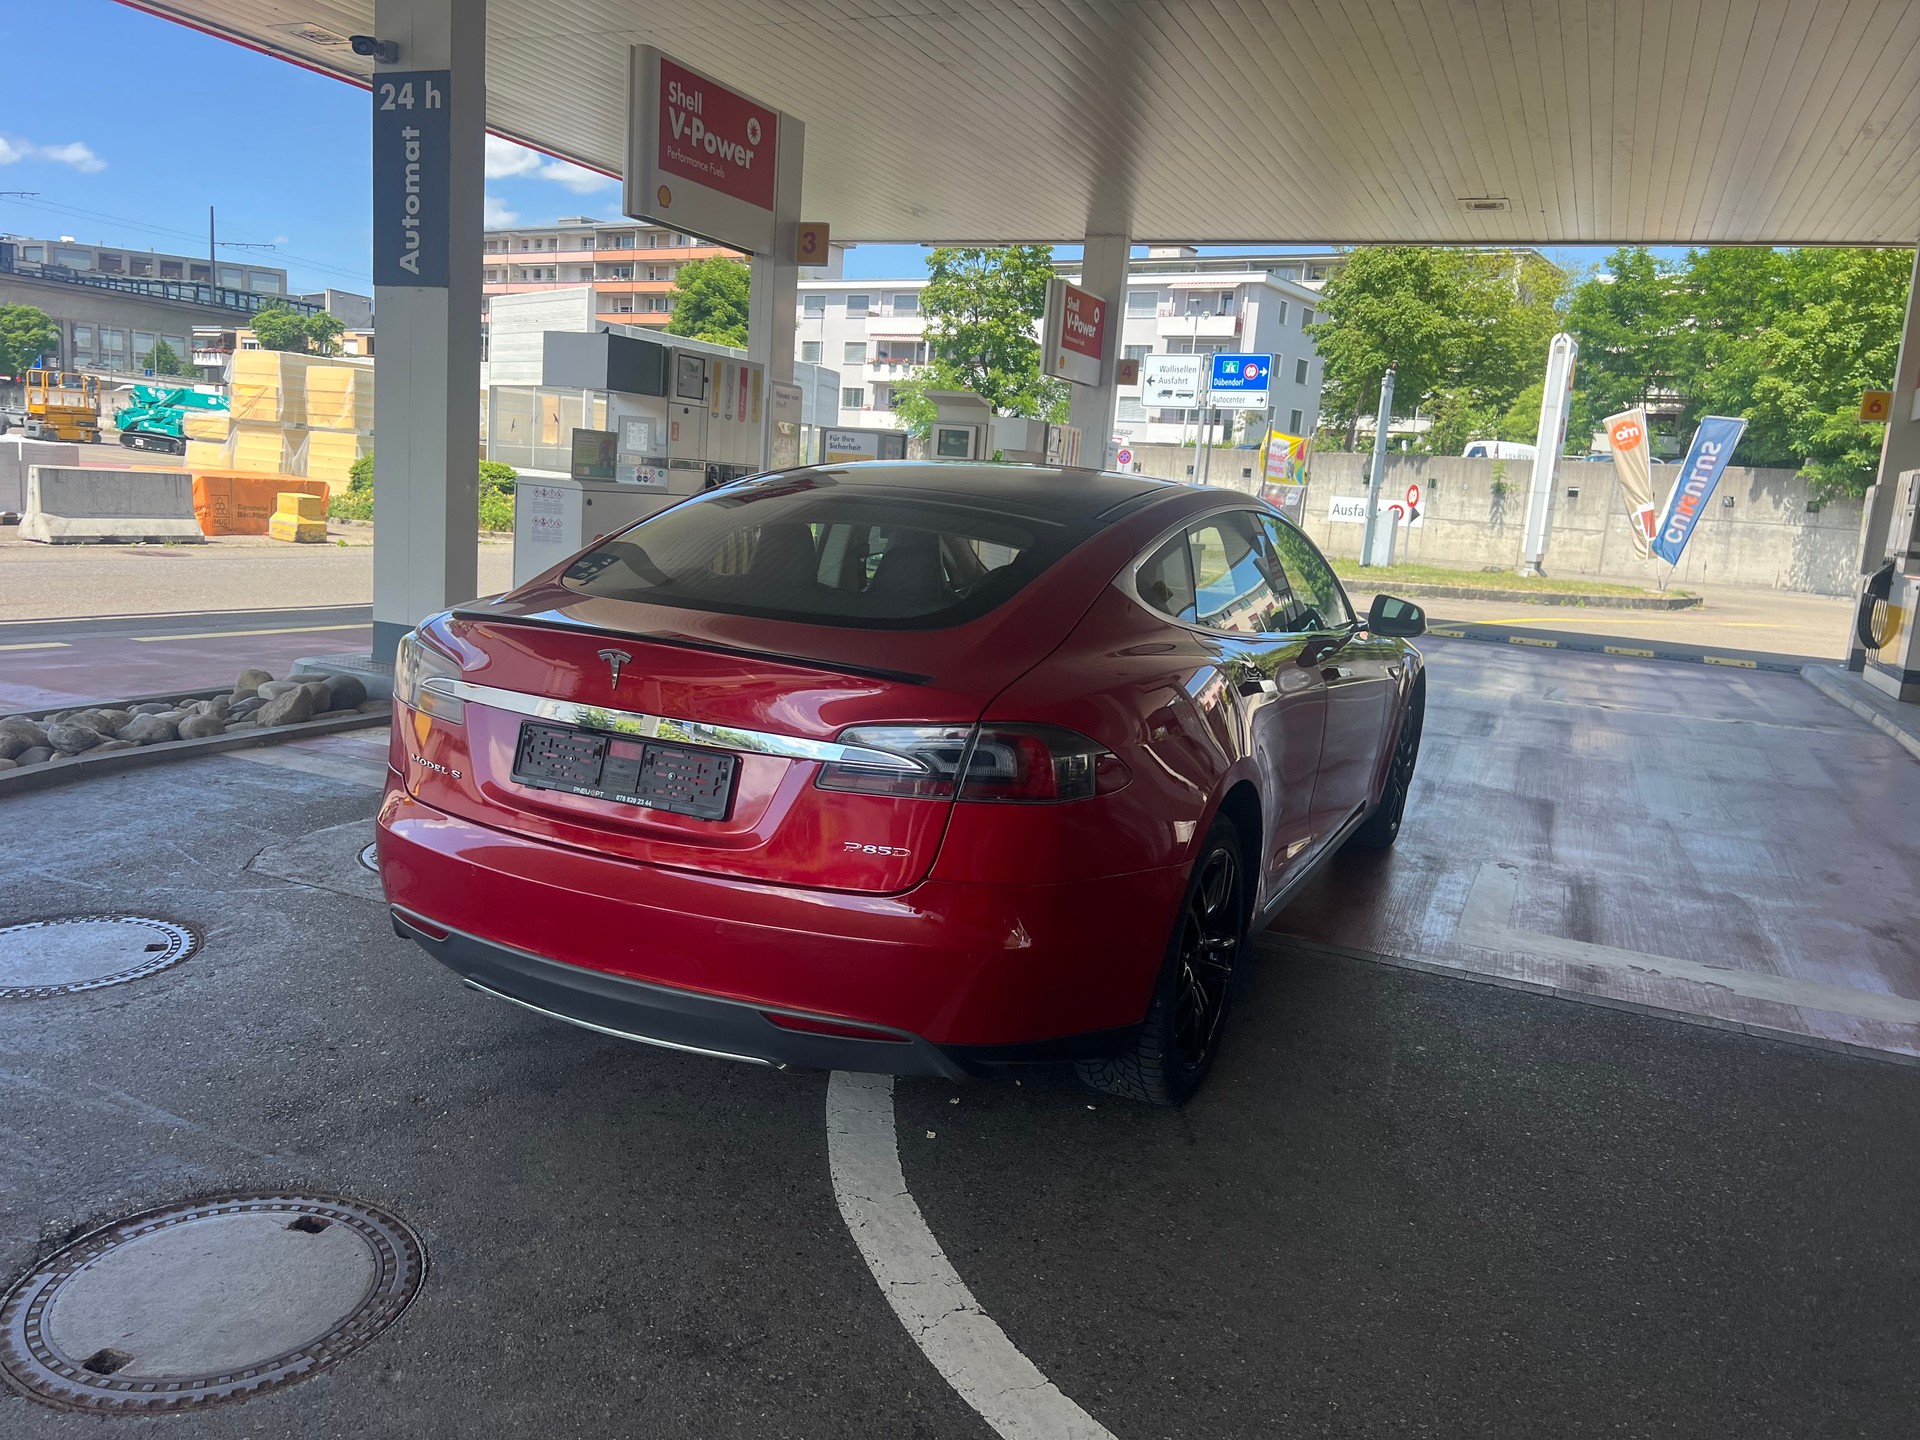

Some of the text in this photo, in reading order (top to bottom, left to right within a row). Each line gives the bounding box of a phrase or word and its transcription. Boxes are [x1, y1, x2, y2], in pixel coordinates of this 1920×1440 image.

[379, 80, 441, 111] 24 h
[668, 80, 702, 115] Shell
[668, 106, 754, 169] V-Power
[666, 144, 725, 178] Performance Fuels
[399, 126, 420, 275] Automat
[801, 231, 817, 254] 3
[1067, 296, 1080, 313] Shell
[1066, 310, 1097, 338] V-Power
[1122, 364, 1133, 378] 4
[1159, 365, 1197, 374] Wallisellen
[1158, 376, 1188, 385] Ausfahrt
[1213, 377, 1245, 387] Dübendorf
[1212, 396, 1246, 404] Autocenter
[1869, 399, 1882, 414] 6
[829, 434, 855, 444] Für Ihre
[829, 442, 861, 452] Sicherheit
[1332, 503, 1381, 519] Ausfa
[411, 753, 462, 779] MODEL S
[615, 794, 652, 807] 078 820 23 44
[843, 841, 911, 857] P85D
